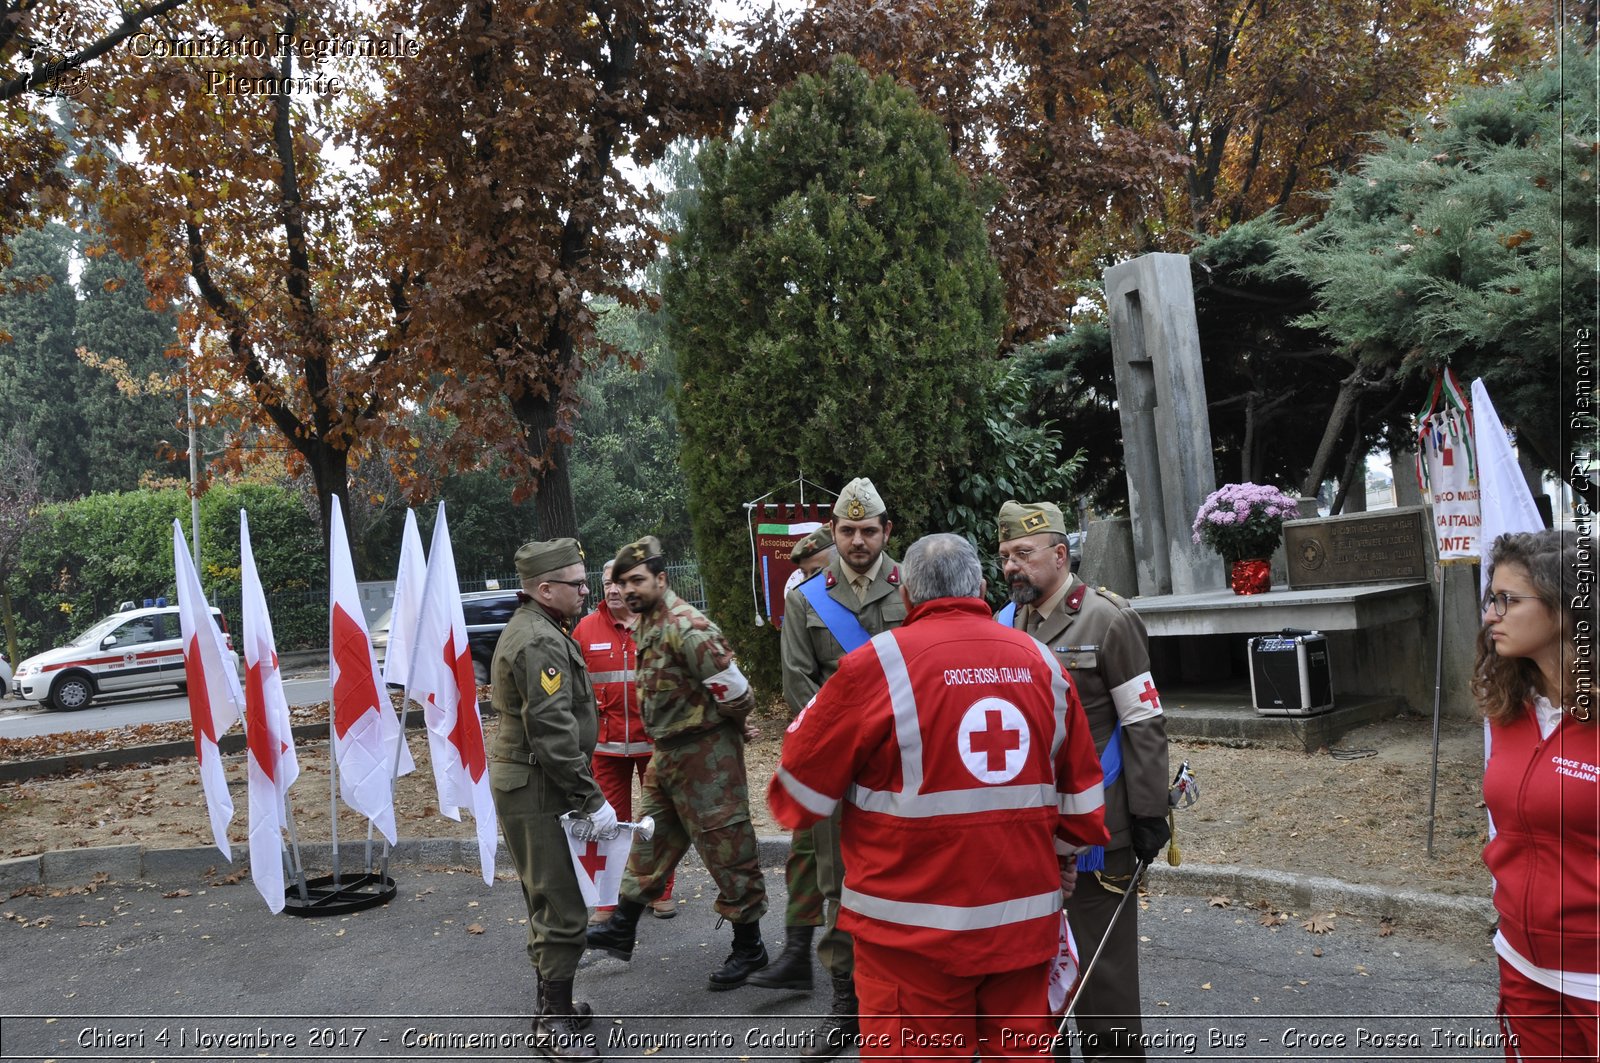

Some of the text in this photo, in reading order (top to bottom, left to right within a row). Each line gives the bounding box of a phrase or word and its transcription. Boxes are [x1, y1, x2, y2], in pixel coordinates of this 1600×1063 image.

[944, 667, 1033, 686] CROCE ROSSA ITALIANA
[1551, 756, 1580, 769] CROCE
[1555, 766, 1597, 782] ITALIANA
